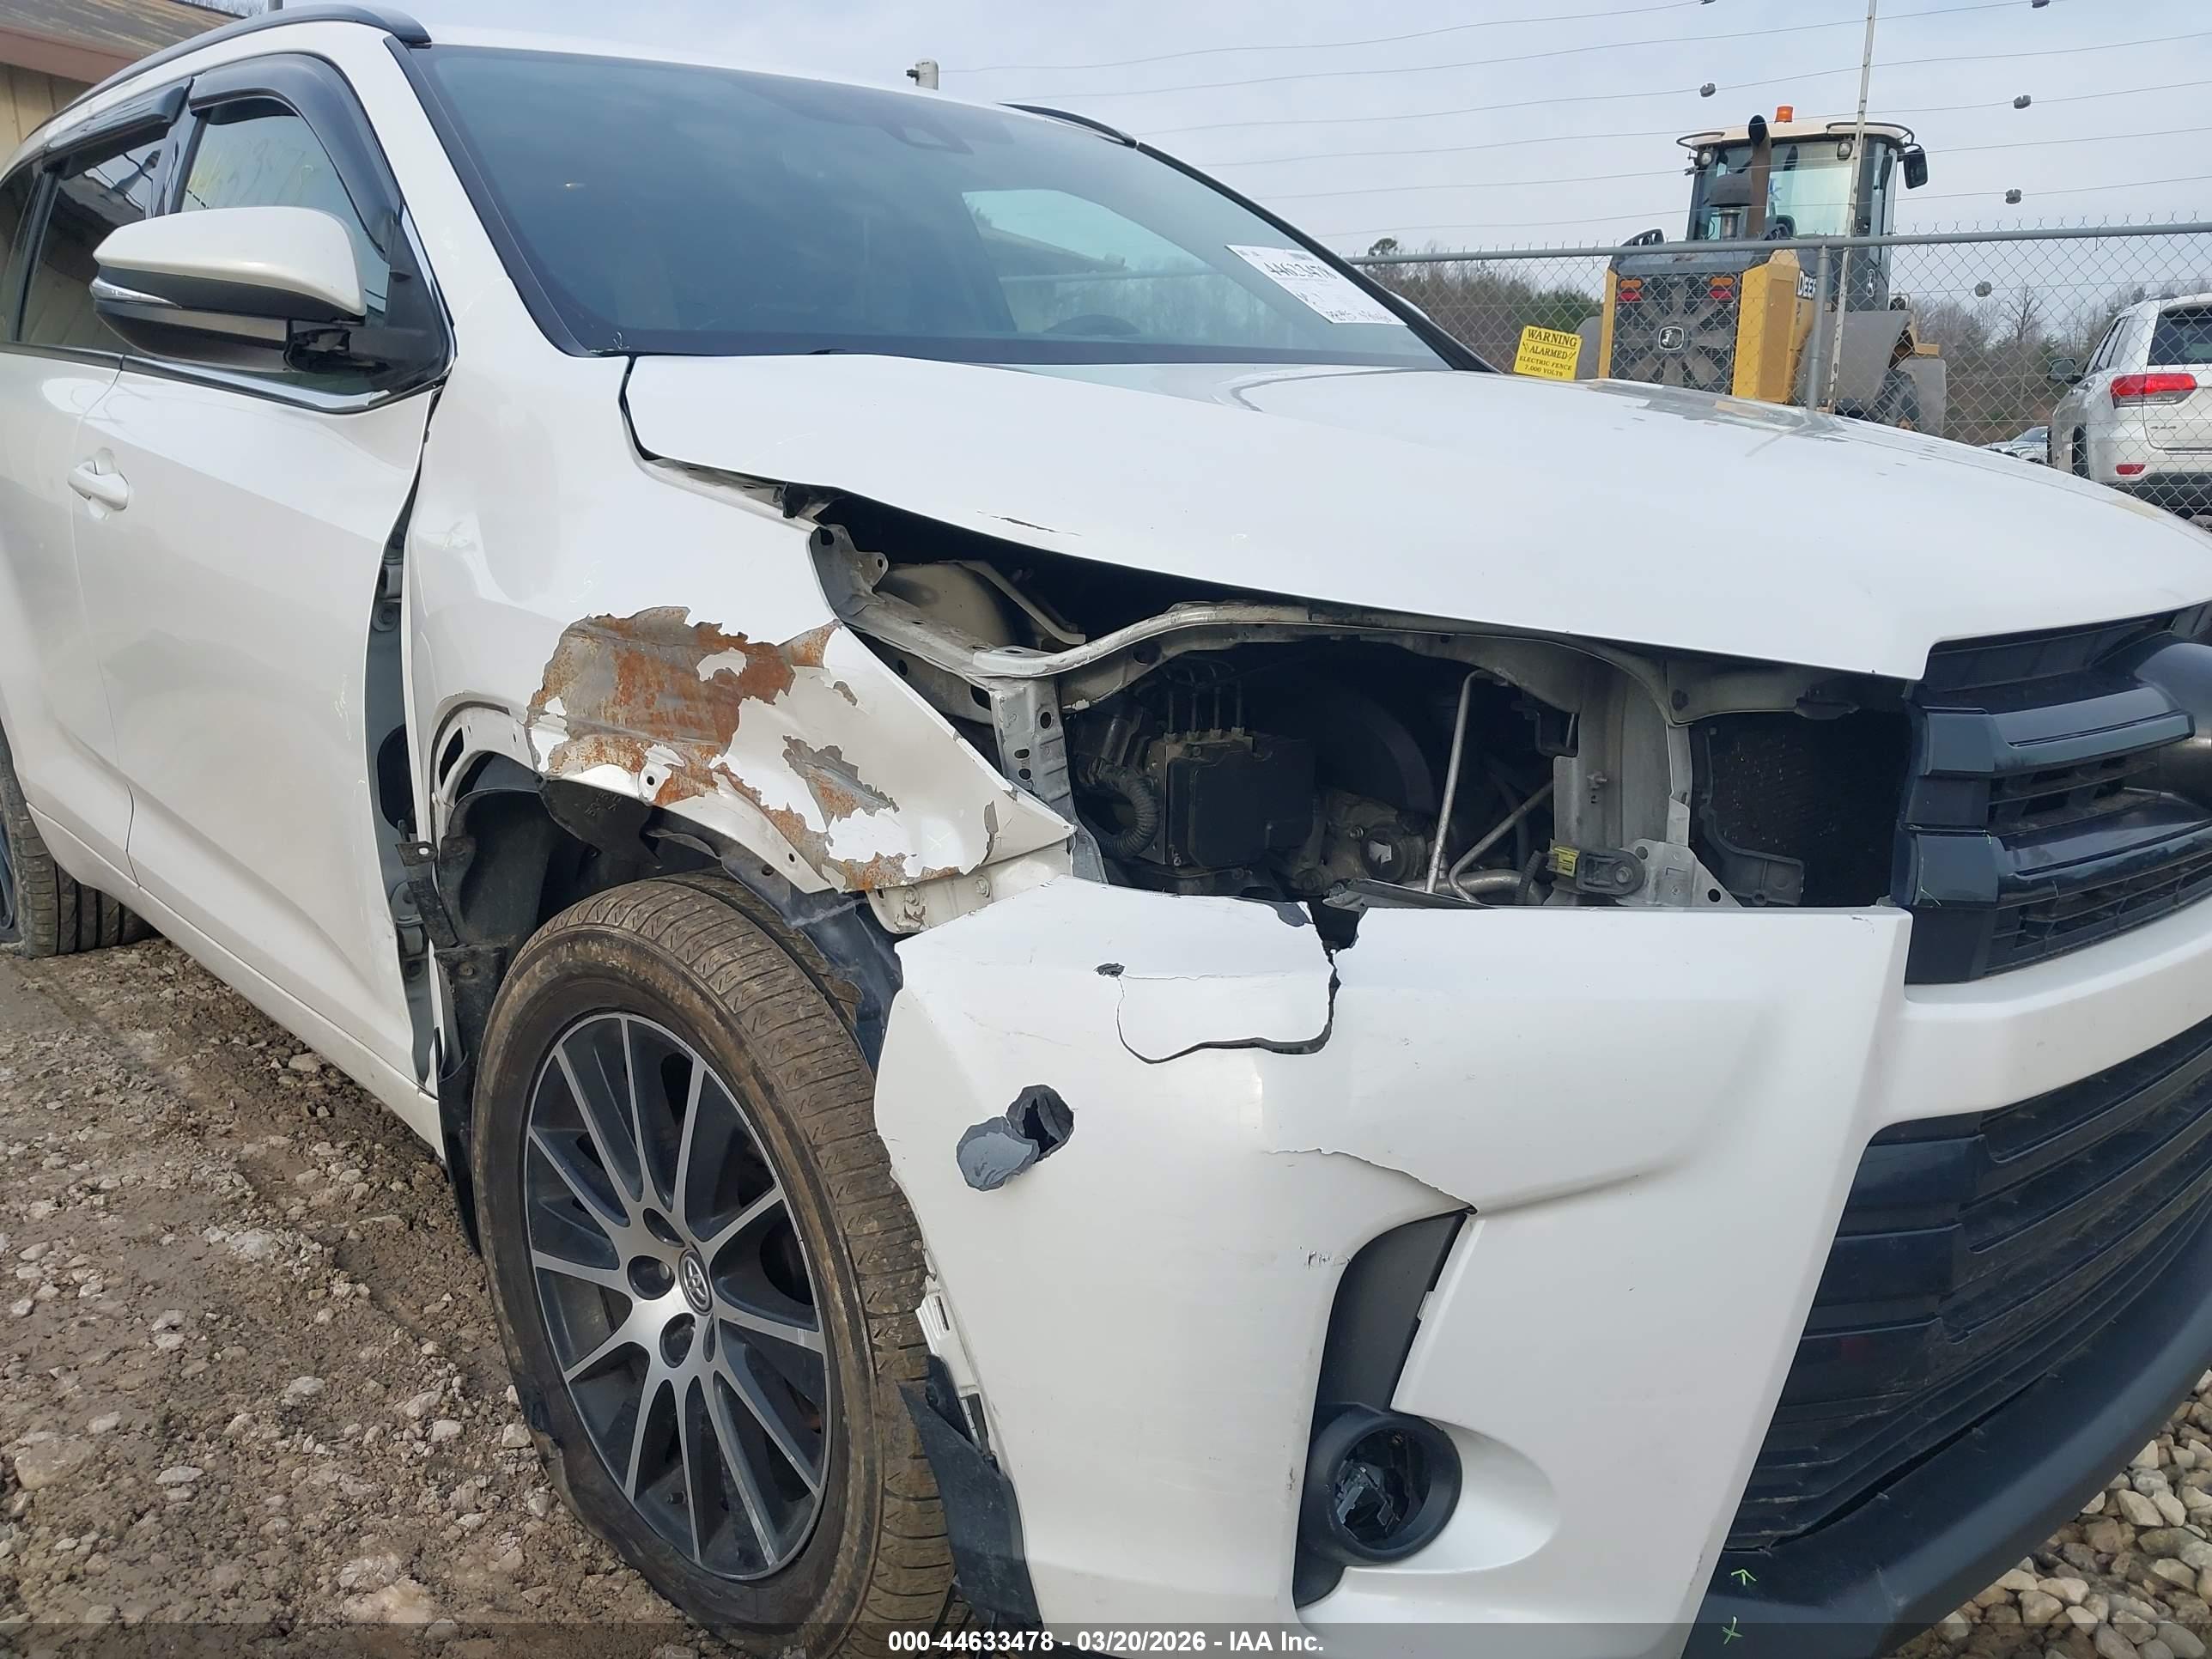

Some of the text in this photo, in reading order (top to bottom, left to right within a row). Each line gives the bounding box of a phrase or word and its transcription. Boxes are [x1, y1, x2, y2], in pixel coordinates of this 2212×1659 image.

[1528, 329, 1577, 347] WARNING
[1529, 345, 1568, 360] ALARMED
[1519, 356, 1572, 371] ELECTRIC FENCE
[1543, 368, 1564, 377] VOLTS
